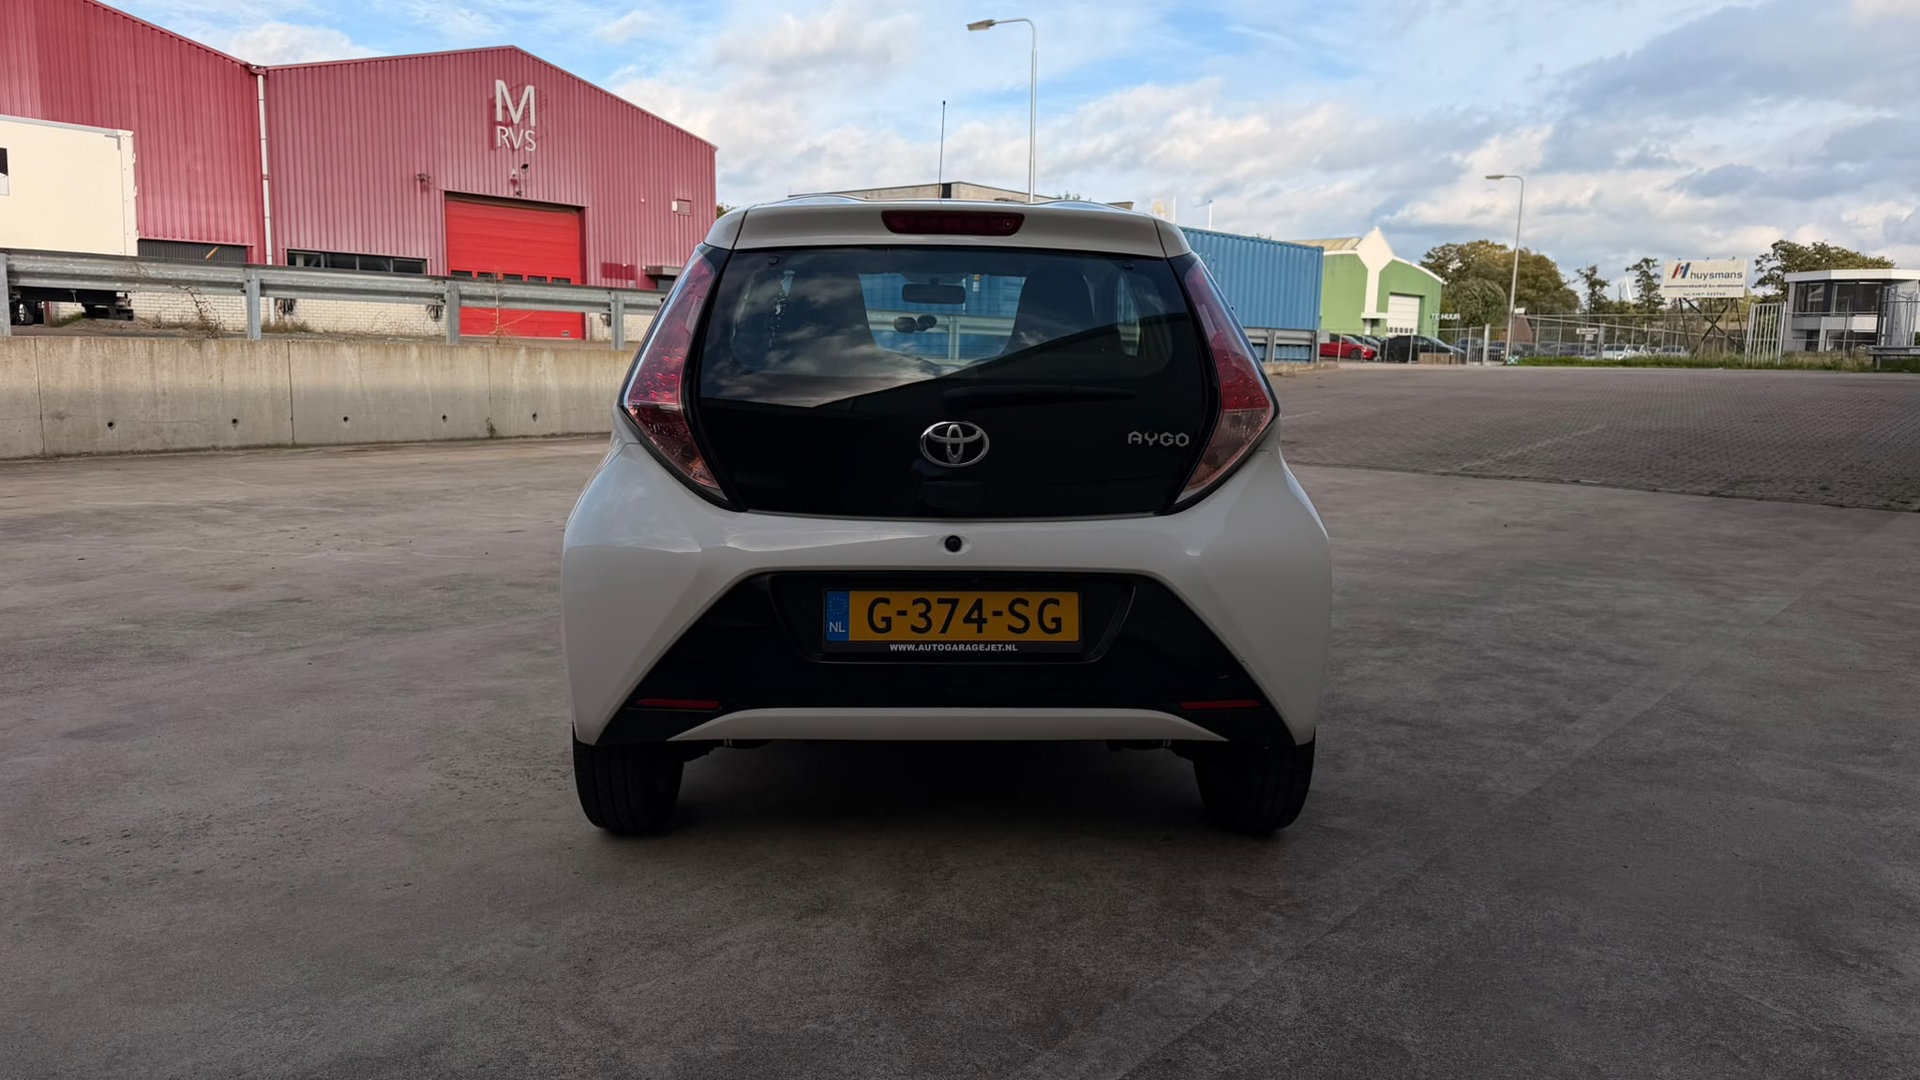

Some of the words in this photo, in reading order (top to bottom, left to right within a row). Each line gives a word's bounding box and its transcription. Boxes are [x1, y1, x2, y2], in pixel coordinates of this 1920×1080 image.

[496, 79, 536, 127] M
[497, 126, 537, 152] RVS
[1689, 271, 1743, 280] huysmans
[1127, 430, 1190, 447] AYGO
[866, 597, 1063, 635] G-374-SG
[829, 621, 846, 633] NL
[889, 643, 1018, 652] WWW.AUTOGARAGEJET.NL
